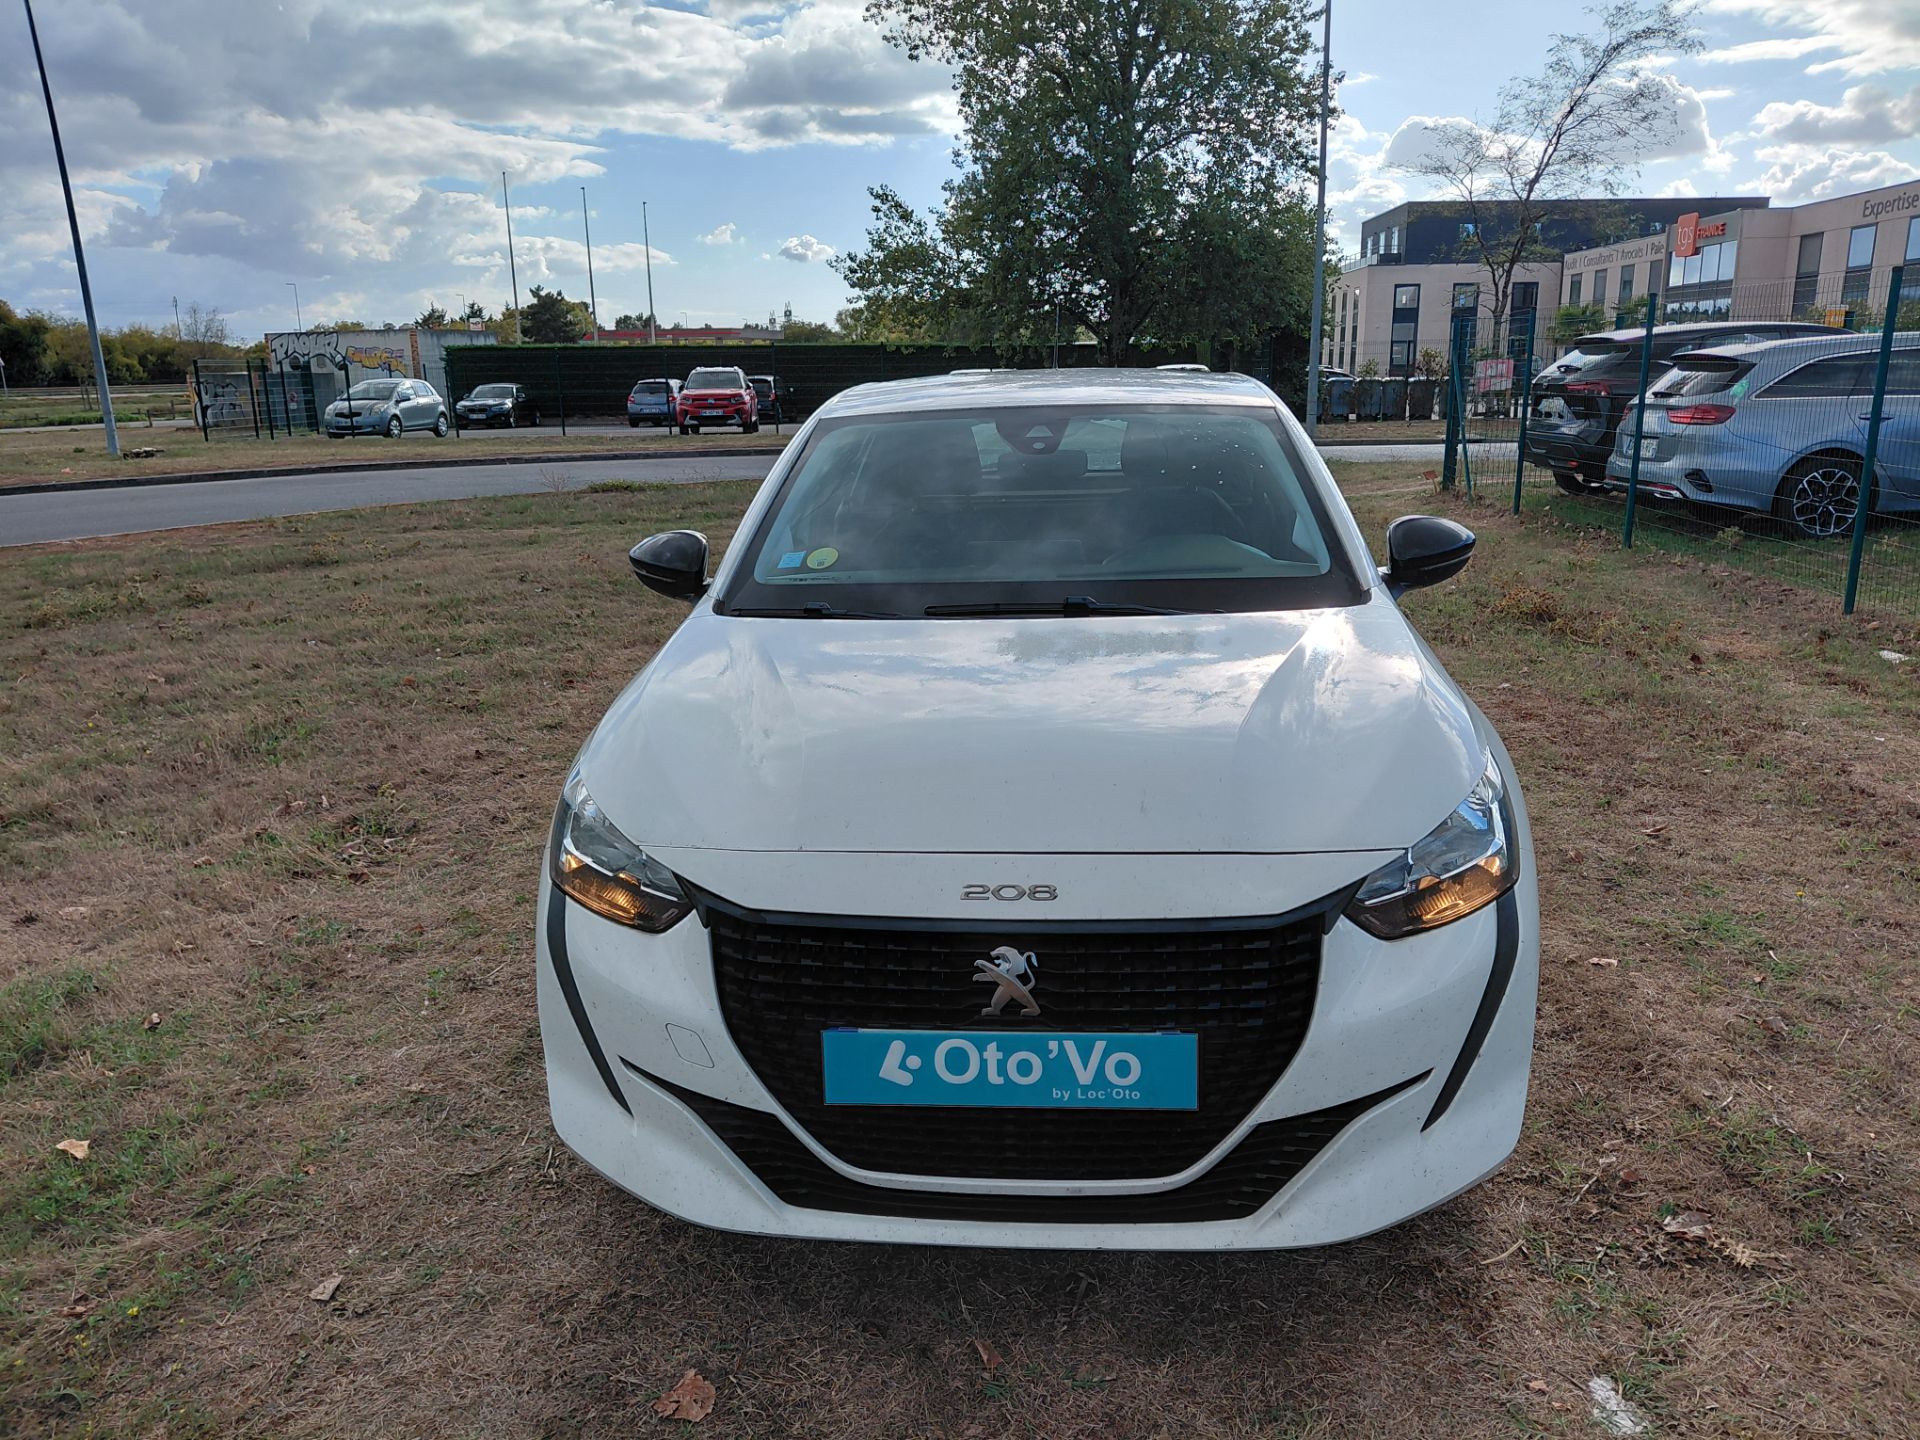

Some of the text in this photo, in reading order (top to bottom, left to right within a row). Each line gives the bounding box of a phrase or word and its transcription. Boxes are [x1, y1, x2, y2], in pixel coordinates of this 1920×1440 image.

[1862, 192, 1920, 220] Expertise
[1677, 222, 1727, 250] tgs FRANCE
[1621, 246, 1644, 260] Avocats
[1651, 241, 1665, 255] Paie
[960, 884, 1059, 901] 208
[934, 1038, 1142, 1086] Oto'Vo
[1052, 1087, 1141, 1100] by Loc'Oto
